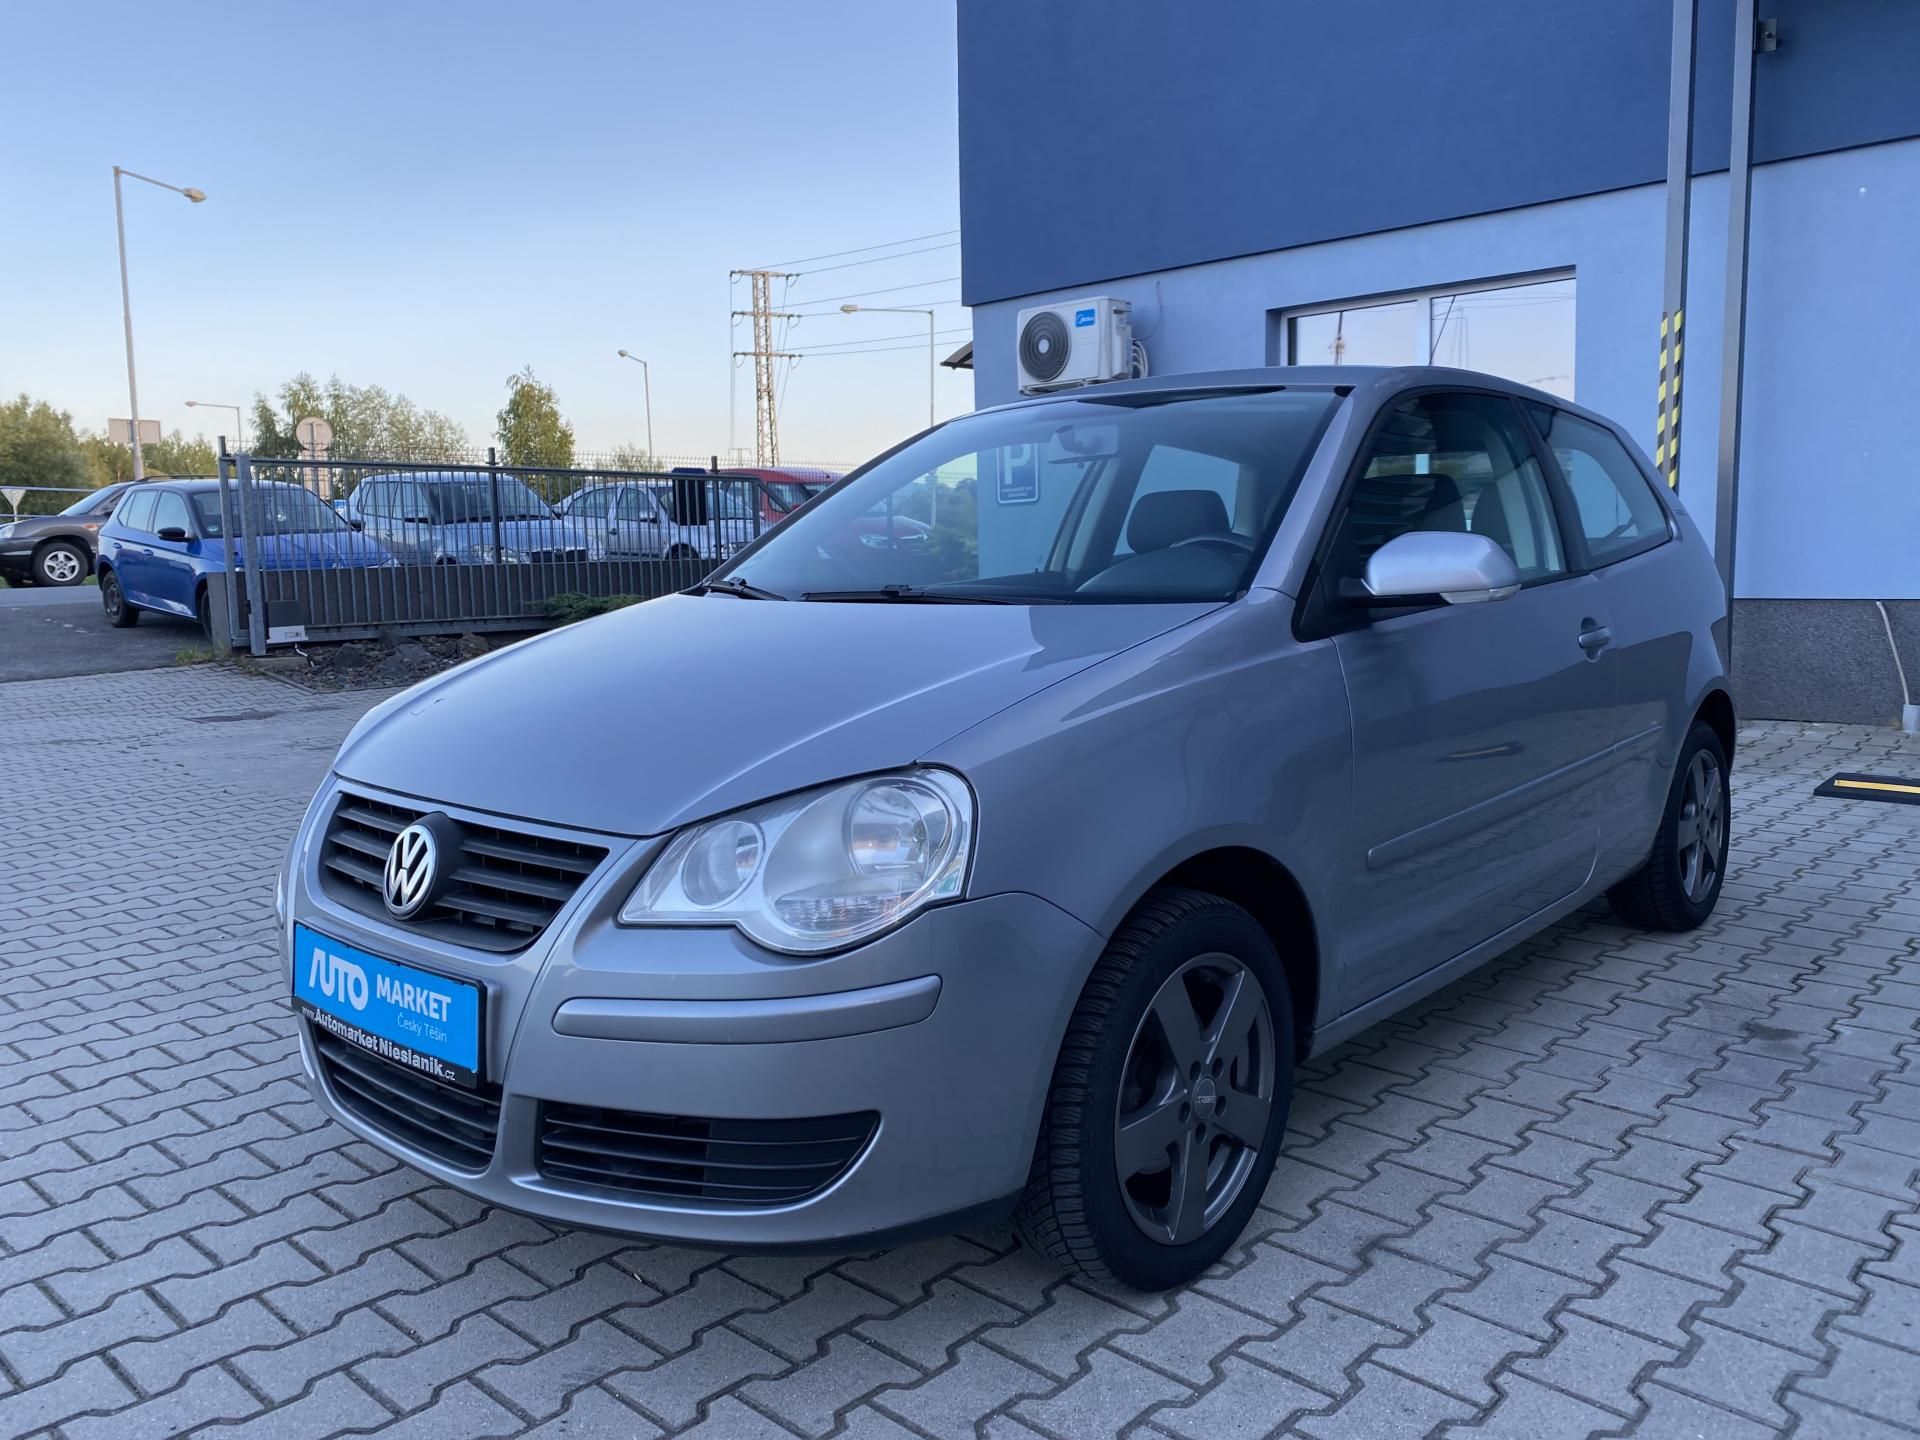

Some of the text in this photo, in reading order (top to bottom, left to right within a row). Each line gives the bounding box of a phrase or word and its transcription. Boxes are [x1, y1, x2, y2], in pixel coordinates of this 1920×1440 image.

[1004, 444, 1031, 485] P
[387, 827, 431, 908] VW
[309, 948, 452, 1022] AUTO MARKET
[380, 1038, 456, 1081] Nieslanik.cz
